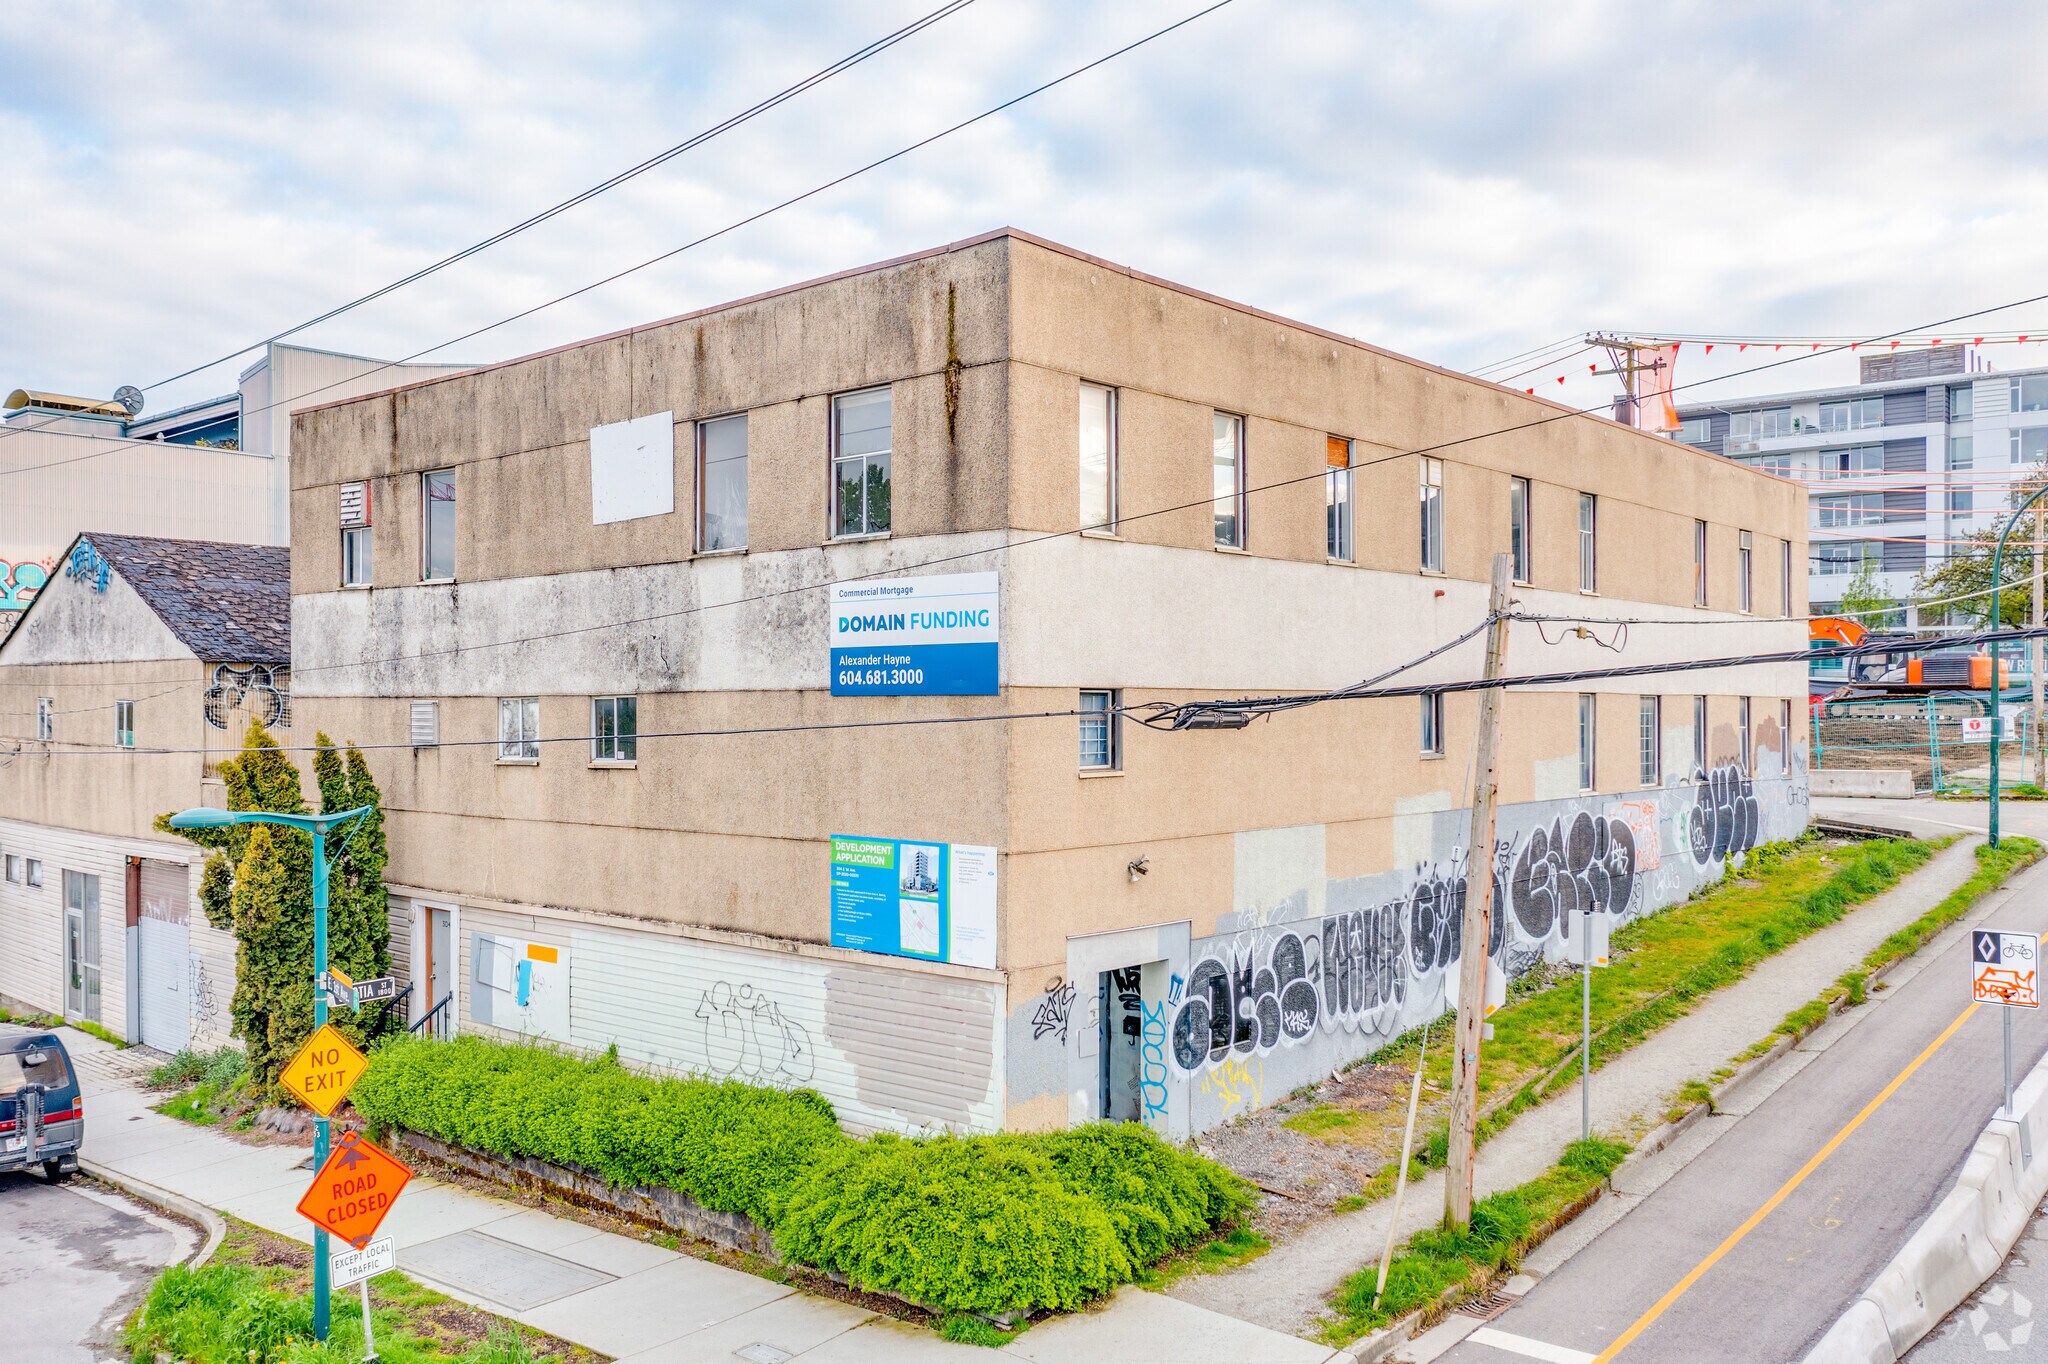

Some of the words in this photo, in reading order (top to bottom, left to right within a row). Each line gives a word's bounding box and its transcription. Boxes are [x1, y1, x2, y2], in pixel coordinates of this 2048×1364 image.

[839, 587, 879, 598] Commercial
[879, 585, 914, 597] Mortgage
[839, 614, 905, 633] DOMAIN
[910, 609, 990, 630] FUNDING
[839, 655, 881, 666] Alexander
[883, 654, 911, 667] Hayne
[839, 668, 924, 685] 604.681.3000
[835, 841, 892, 855] DEVELOPMENT
[835, 852, 885, 866] APPLICATION
[377, 987, 392, 996] 1800
[311, 1049, 340, 1068] NO
[305, 1070, 346, 1093] EXIT
[332, 1173, 377, 1200] ROAD
[326, 1192, 388, 1224] CLOSED
[335, 1252, 363, 1270] EXCEPT
[366, 1243, 390, 1258] LOCAL
[348, 1259, 379, 1278] TRAFFIC
